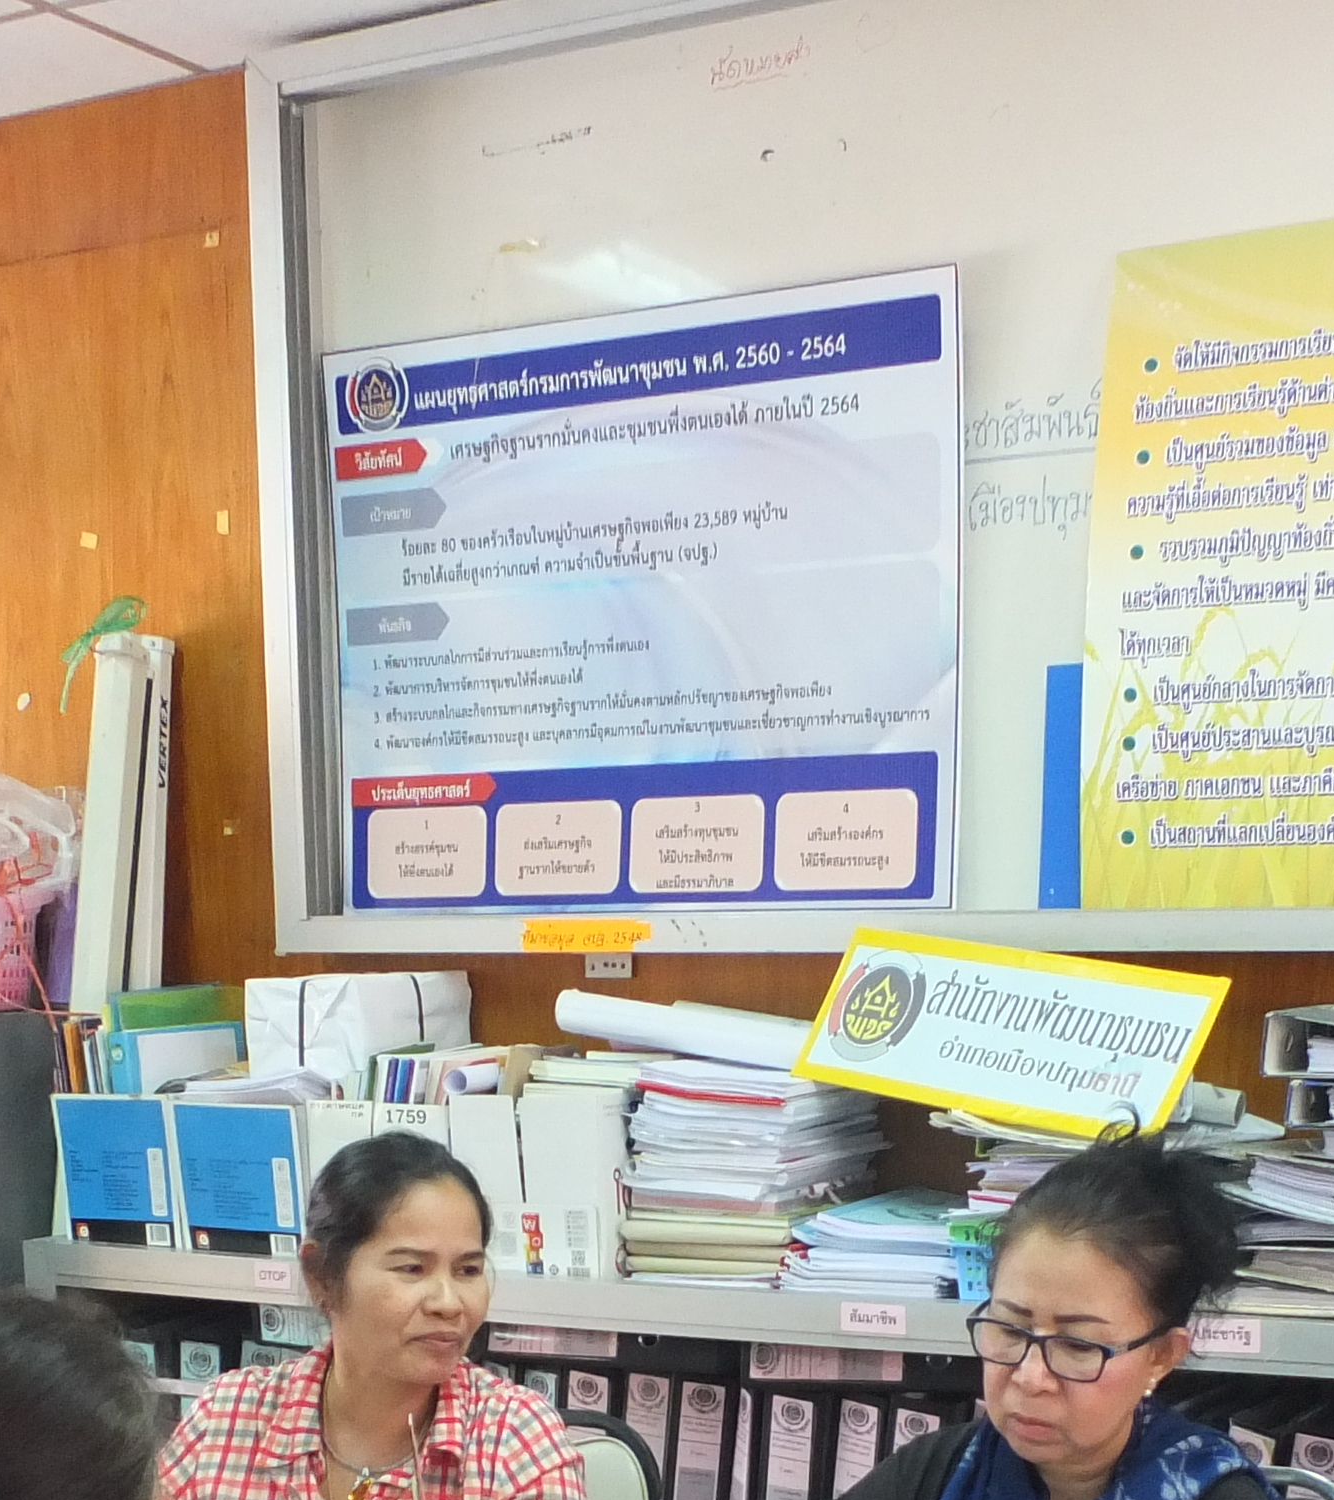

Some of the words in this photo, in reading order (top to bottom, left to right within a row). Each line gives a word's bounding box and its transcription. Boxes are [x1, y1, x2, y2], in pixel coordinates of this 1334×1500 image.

[413, 357, 687, 414] แผนยุทธศาสตร์กรมการพัฒนาชุมชน
[693, 350, 729, 374] พ.ศ.
[736, 341, 781, 369] 2560
[801, 332, 847, 361] 2564
[449, 401, 748, 464] เศรษฐกิจฐานรากมั่นคงและชุมชนพึ่งตนเองได้
[754, 394, 815, 424] ภายในปี
[820, 393, 860, 416] 2564
[1166, 426, 1328, 473] เป็นศูนย์รวมของข้อมูล
[1127, 469, 1308, 525] ความรู้ที่เอื้อต่อการเรียนรู้
[441, 537, 457, 553] 80
[693, 510, 738, 530] 23,589
[743, 500, 789, 530] หมู่บ้าน
[1122, 570, 1310, 612] และจัดการให้เป็นหมวดหมู่
[1119, 625, 1194, 668] ได้ทุกเวลา
[371, 778, 472, 806] ประเด็นยุทธศาสตร์
[1115, 772, 1178, 803] เครือข่าย
[1184, 768, 1263, 799] ภาคเอกชน
[925, 970, 1193, 1064] สำนักงานพัฒนาชุมชน
[386, 1109, 427, 1125] 1759
[258, 1269, 288, 1282] OTOP
